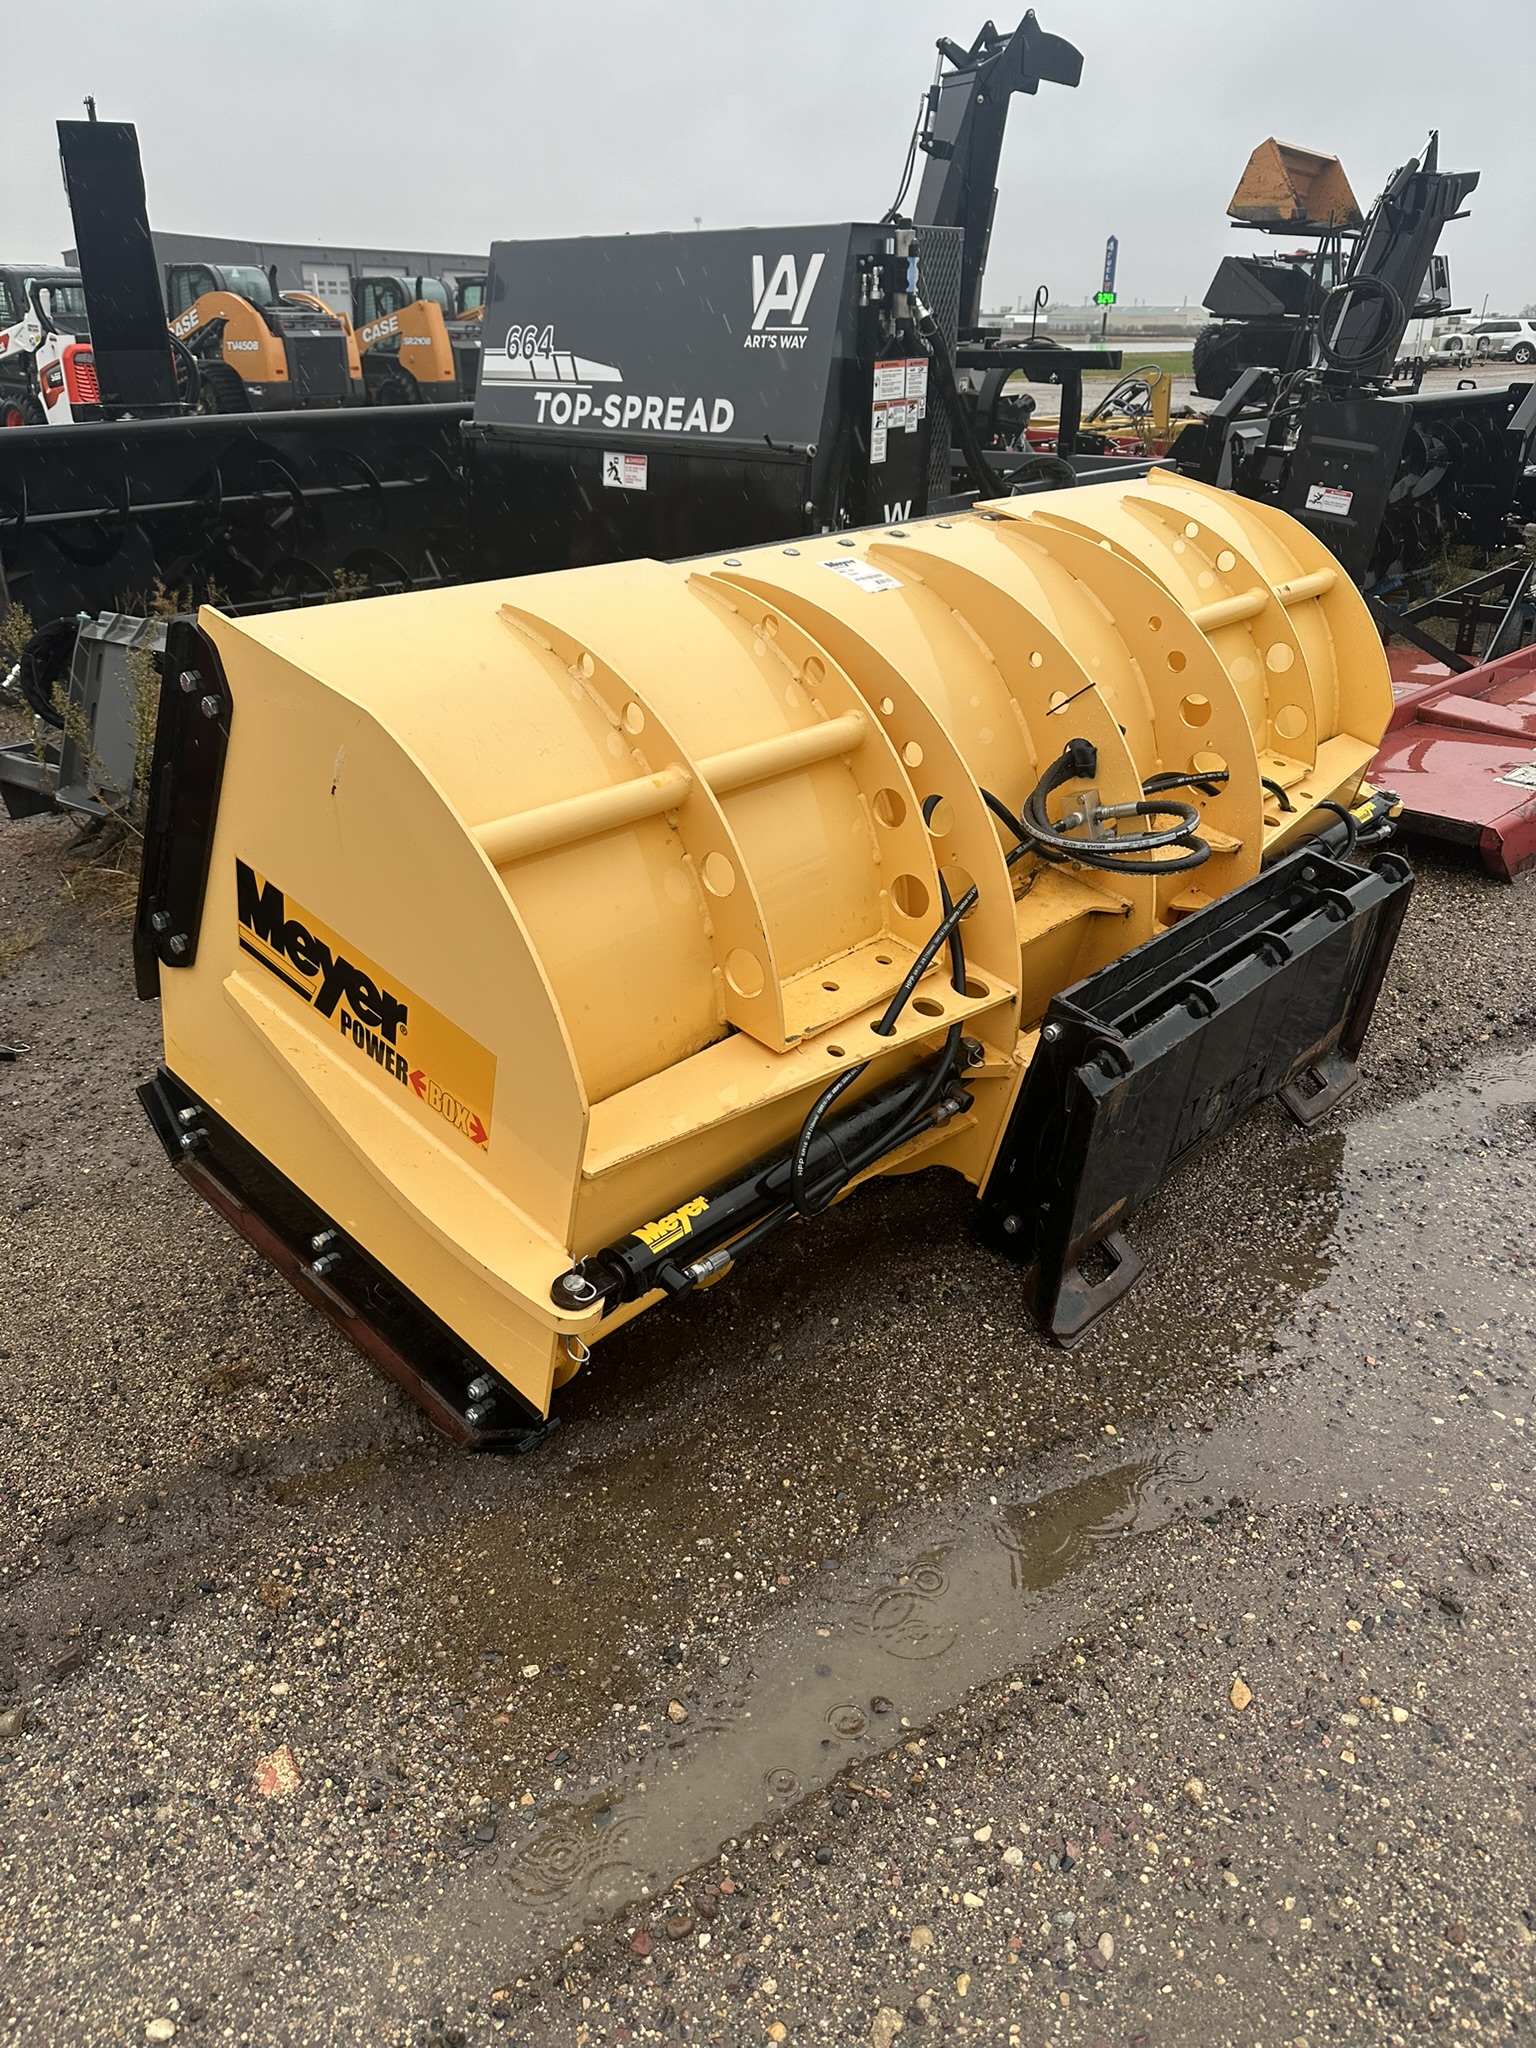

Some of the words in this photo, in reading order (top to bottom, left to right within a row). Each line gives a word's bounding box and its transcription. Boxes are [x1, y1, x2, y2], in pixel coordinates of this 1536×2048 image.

[169, 308, 200, 337] ASE
[362, 315, 399, 343] CASE
[505, 324, 554, 361] 664
[743, 334, 777, 349] ART'S
[780, 335, 808, 349] WAY
[533, 391, 735, 433] TOP-SPREAD
[339, 1007, 409, 1087] POWER
[427, 1079, 471, 1137] BOX
[630, 1195, 710, 1247] Meyer
